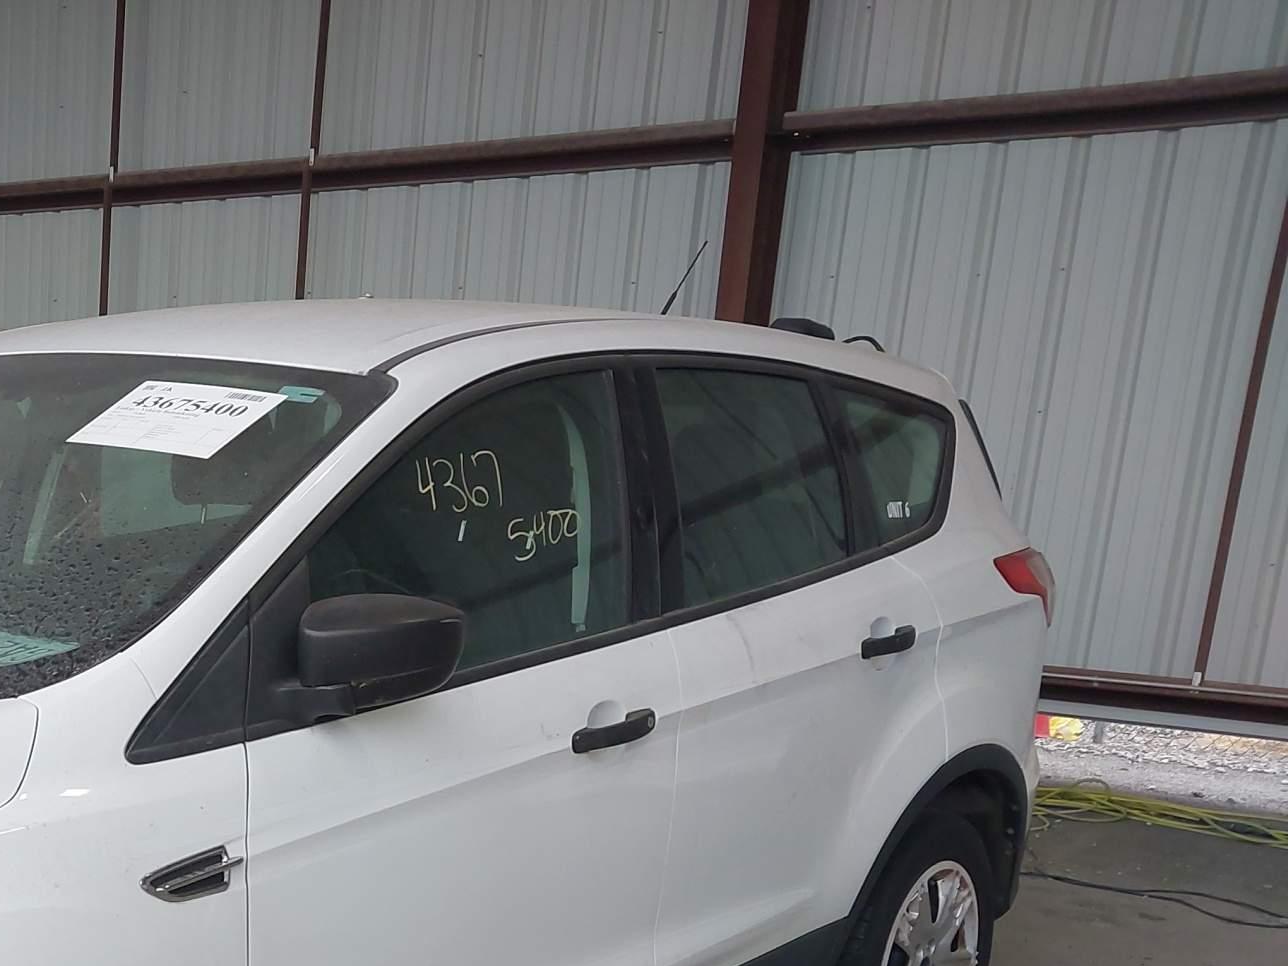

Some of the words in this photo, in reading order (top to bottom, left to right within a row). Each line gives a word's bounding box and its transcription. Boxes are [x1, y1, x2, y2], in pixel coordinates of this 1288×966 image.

[132, 395, 249, 418] 43675400
[415, 449, 503, 513] 4367
[904, 501, 911, 519] 6
[507, 508, 579, 561] 5400
